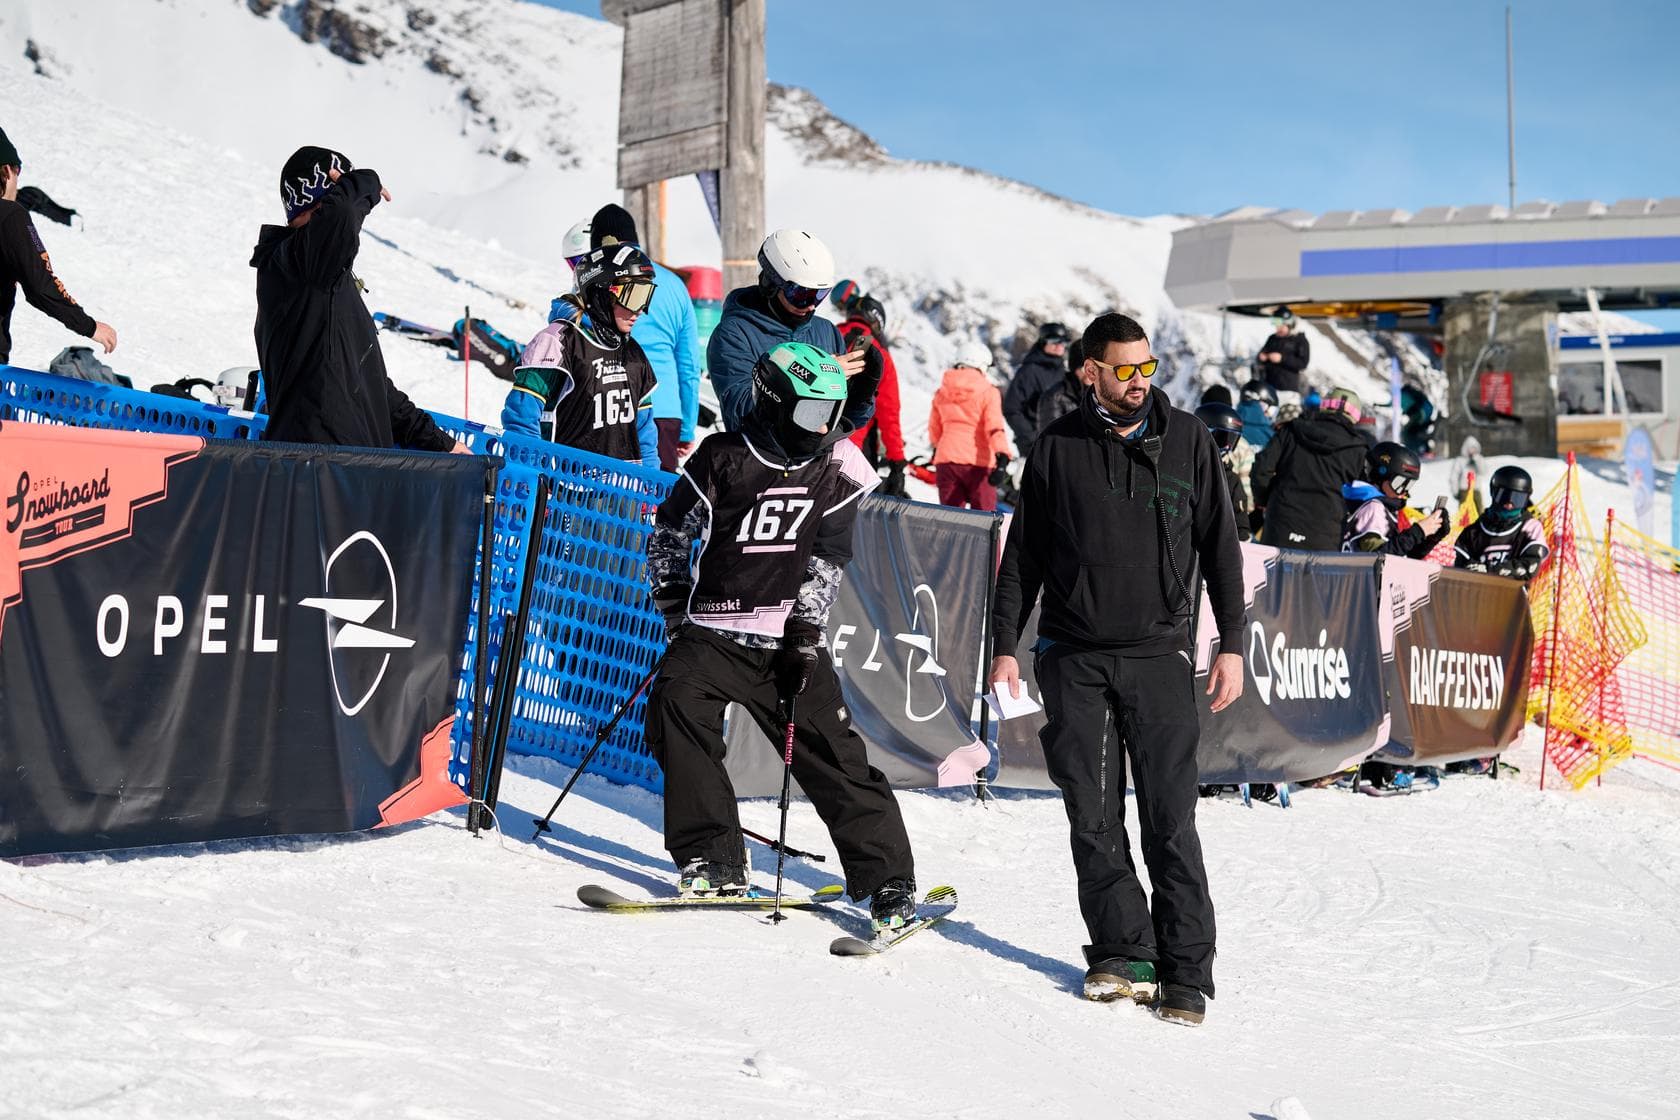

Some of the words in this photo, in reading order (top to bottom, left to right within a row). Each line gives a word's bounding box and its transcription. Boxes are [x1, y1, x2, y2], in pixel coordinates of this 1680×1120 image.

[790, 362, 811, 380] LAAX
[593, 389, 635, 430] 163
[6, 467, 111, 534] Snowboard
[33, 476, 58, 492] OPEL
[735, 499, 815, 543] 167
[96, 594, 278, 658] OPEL
[832, 624, 883, 672] EL
[1271, 628, 1351, 700] Sunrise
[1409, 645, 1505, 711] RAIFFEISEN
